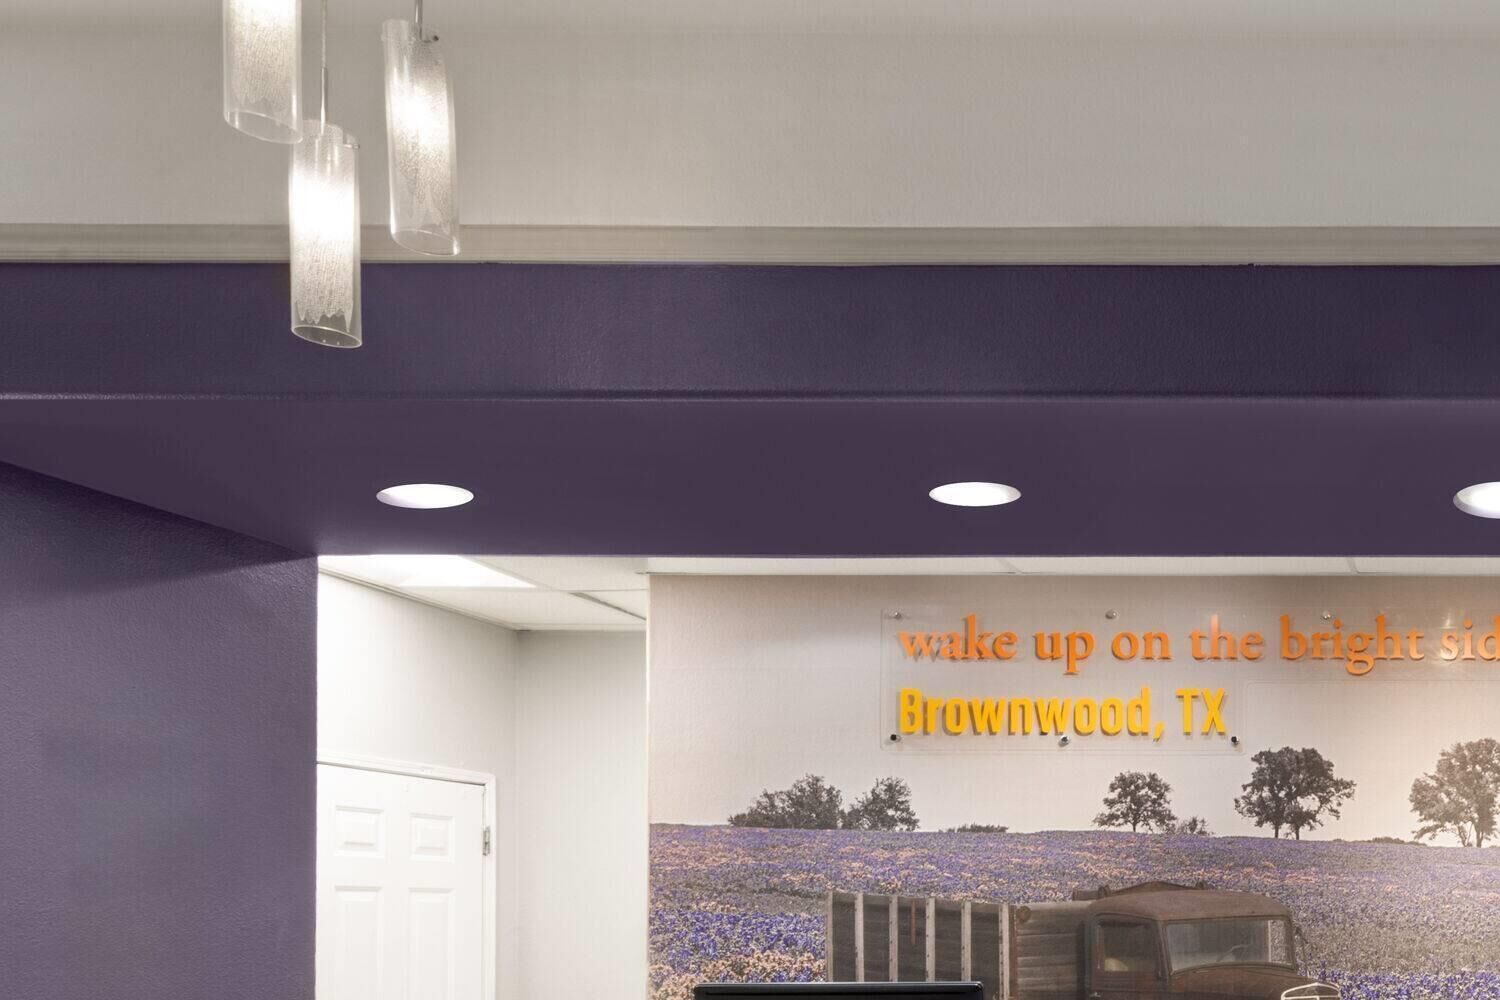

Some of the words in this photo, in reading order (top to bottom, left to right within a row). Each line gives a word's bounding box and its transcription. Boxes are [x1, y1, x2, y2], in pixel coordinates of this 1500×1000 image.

[898, 614, 1018, 660] wake
[1033, 626, 1095, 675] up
[1111, 628, 1171, 660] on
[1189, 614, 1263, 660] the
[1281, 615, 1424, 675] bright
[899, 687, 1165, 741] Brownwood,
[1176, 687, 1228, 734] TX
